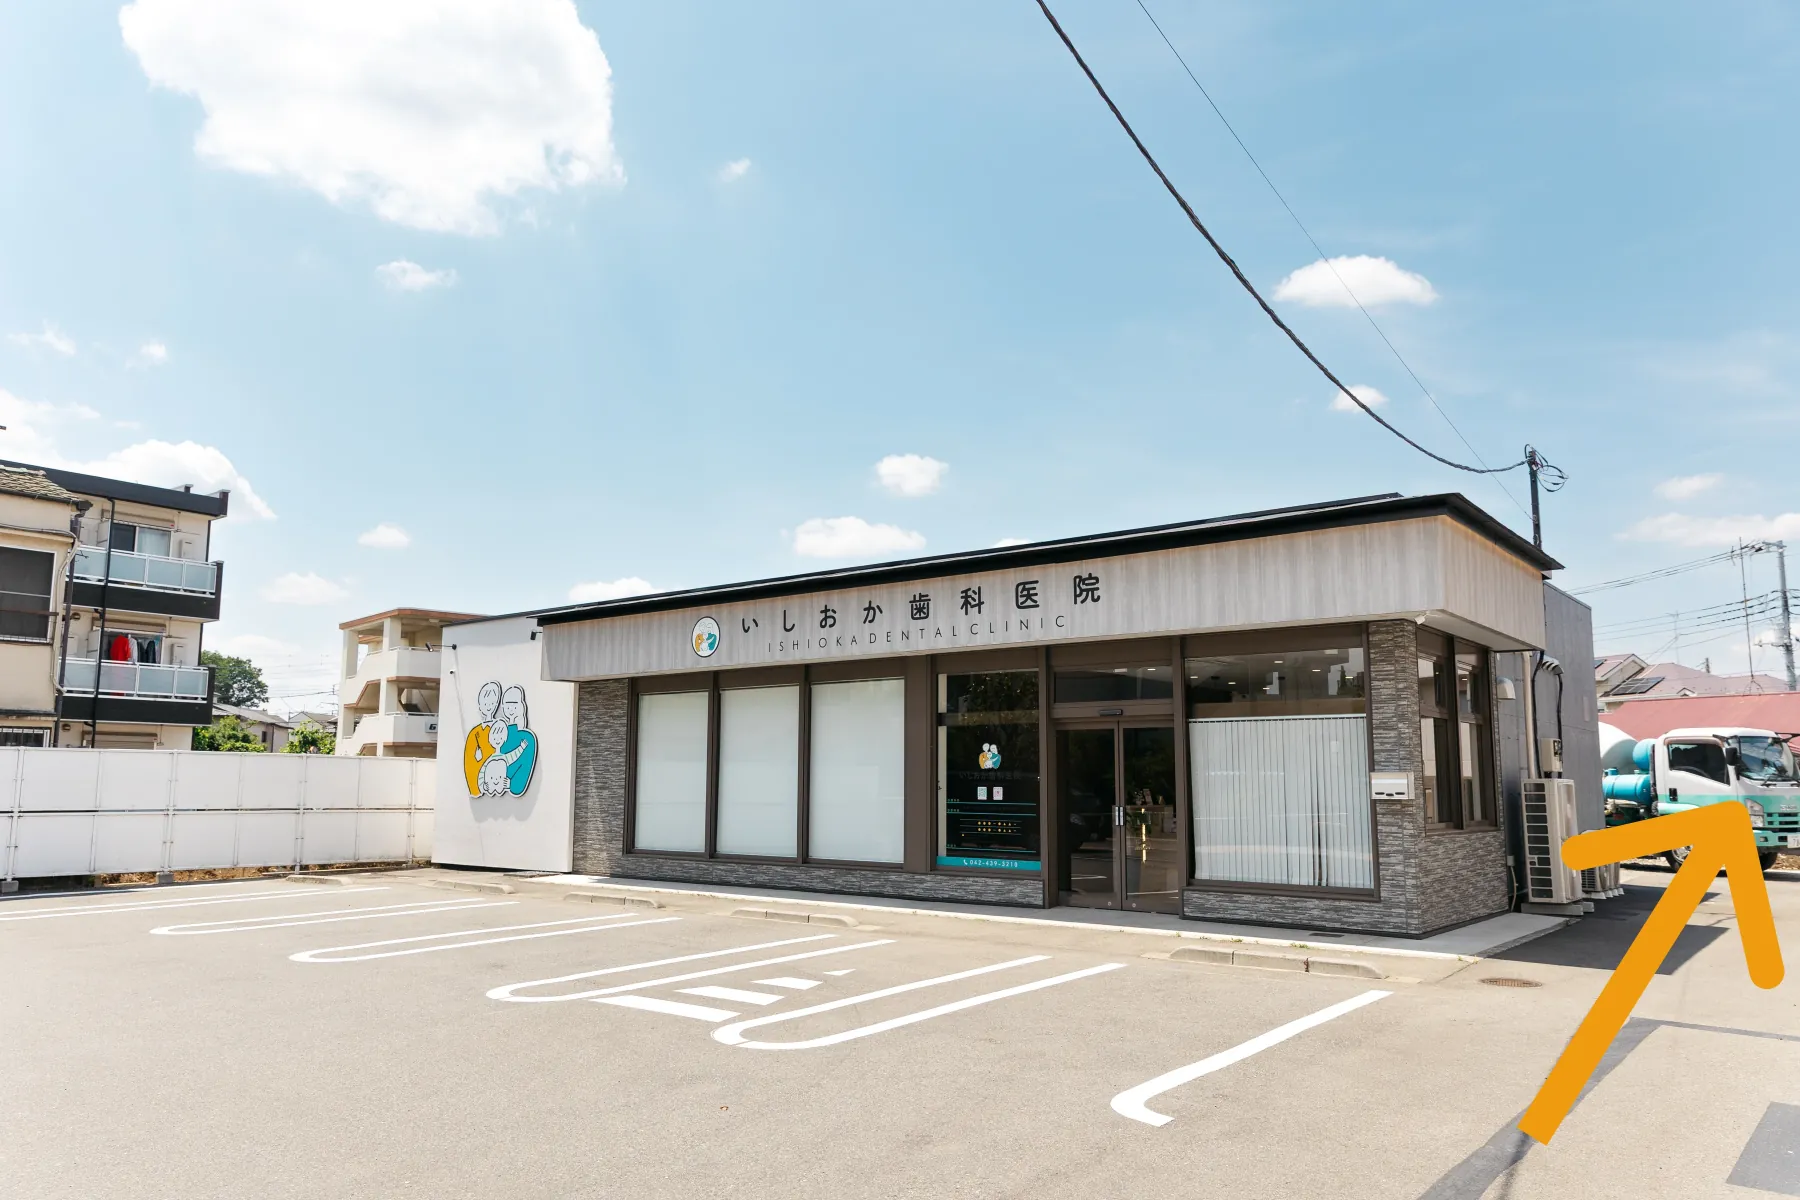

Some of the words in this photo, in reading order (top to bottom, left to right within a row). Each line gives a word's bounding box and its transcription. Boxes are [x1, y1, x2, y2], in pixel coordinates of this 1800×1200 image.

[741, 572, 1101, 634] いしおか歯科医院
